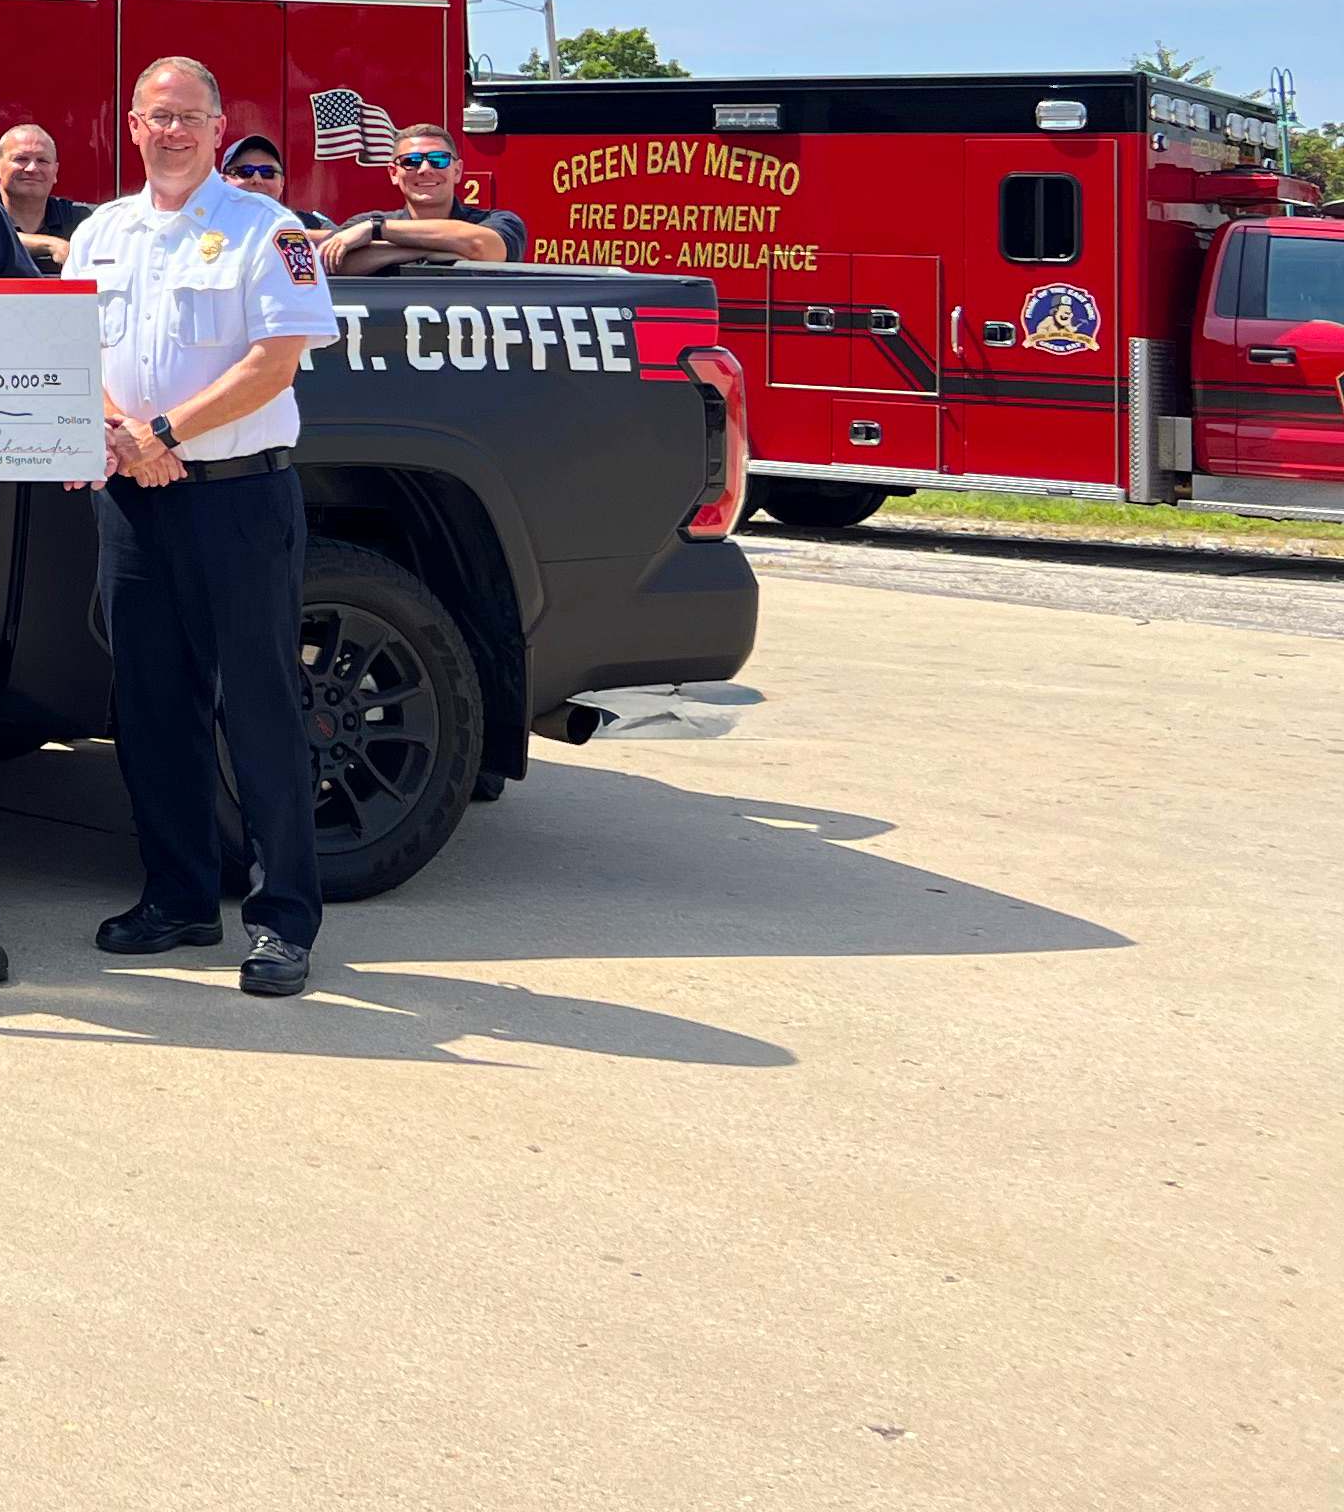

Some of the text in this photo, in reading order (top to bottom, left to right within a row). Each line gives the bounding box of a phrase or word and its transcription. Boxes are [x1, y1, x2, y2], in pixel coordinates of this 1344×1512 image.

[552, 140, 801, 196] GREEN BAY METRO
[463, 179, 480, 205] 2
[569, 203, 781, 233] FIRE DEPARTMENT
[533, 238, 661, 267] PARAMEDIC
[676, 242, 820, 272] AMBULANCE
[58, 416, 92, 425] Dollars
[5, 456, 52, 466] Signature
